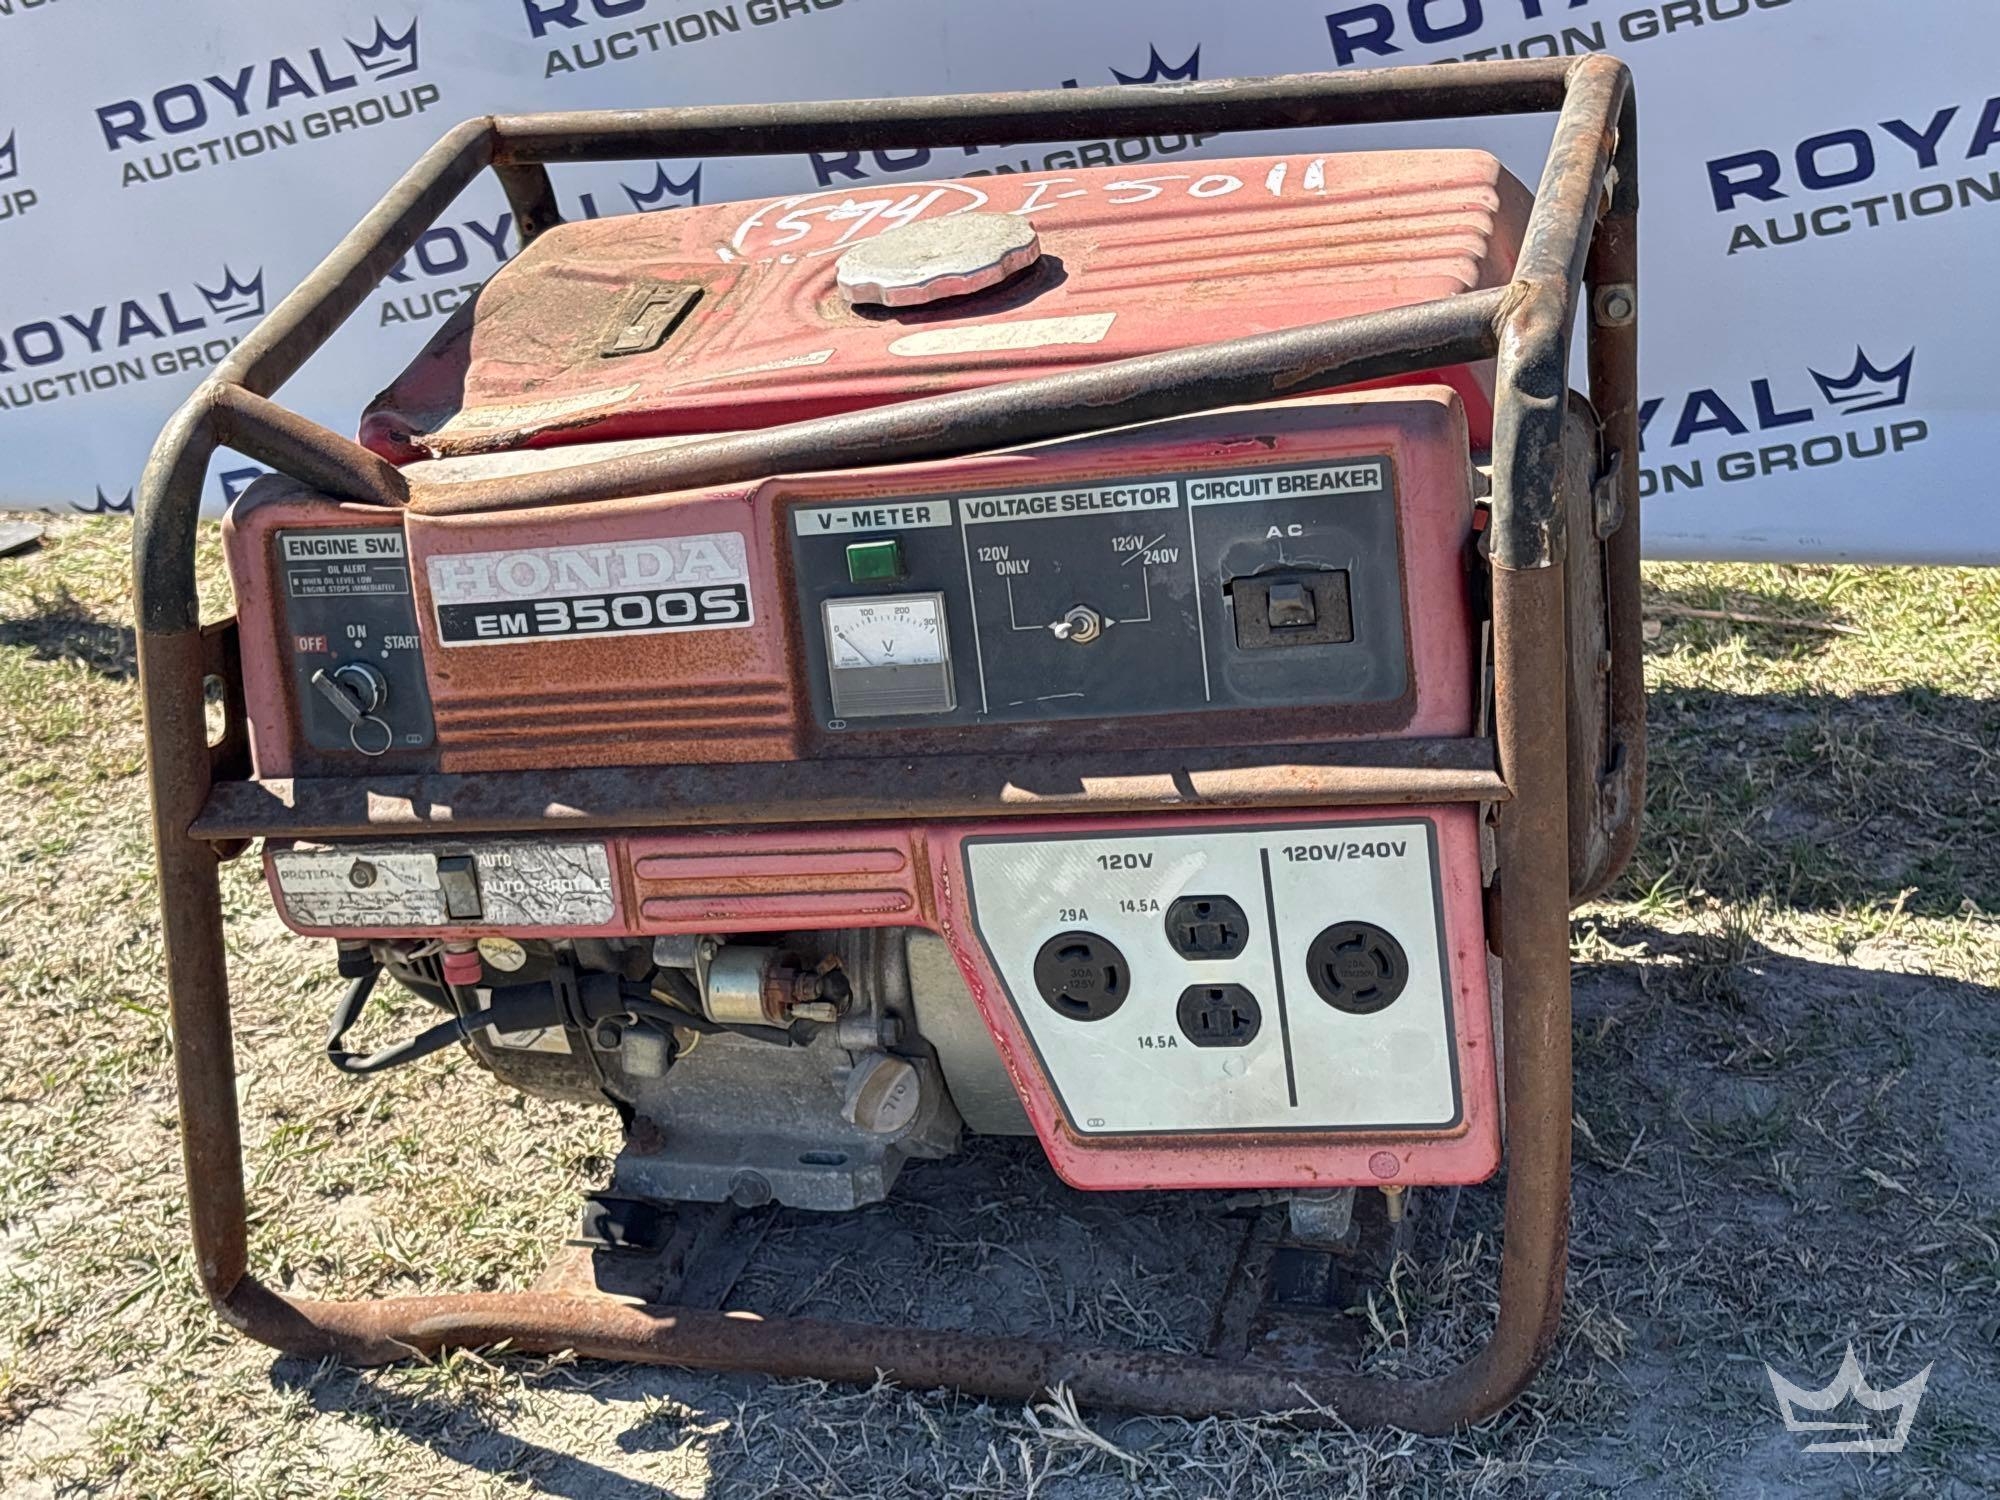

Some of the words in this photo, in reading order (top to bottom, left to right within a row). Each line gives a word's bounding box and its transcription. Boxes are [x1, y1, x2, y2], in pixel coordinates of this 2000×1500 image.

[545, 5, 740, 78] AUCTION
[96, 47, 358, 151] ROYAL
[122, 120, 298, 187] AUCTION
[303, 83, 441, 140] GROUP
[1043, 132, 1220, 171] GROU
[1726, 172, 2000, 256] AUCTION
[0, 292, 206, 373] OYAL
[1716, 419, 1929, 482] GROUP
[1190, 477, 1273, 501] CIRCUIT
[1276, 468, 1379, 494] BREAKER
[965, 496, 1058, 519] VOLTAGE
[1061, 486, 1171, 512] SELECTOR
[288, 539, 359, 556] ENGINE
[365, 537, 400, 554] SW.
[1111, 535, 1144, 552] 120V
[976, 545, 1010, 562] 120V
[1143, 548, 1179, 565] 240V
[432, 540, 740, 598] HONDA
[996, 560, 1030, 575] ONLY
[860, 608, 874, 616] 100
[894, 606, 910, 615] 200
[346, 624, 367, 638] ON
[299, 637, 323, 651] OFF
[384, 635, 419, 649] START
[882, 639, 894, 653] V
[478, 853, 512, 867] AUTO
[1282, 841, 1408, 862] 120V/240V
[1097, 853, 1153, 870] 120V
[1119, 899, 1160, 913] 14.5A
[1058, 908, 1089, 922] 29A
[1138, 1035, 1178, 1049] 14.5A
